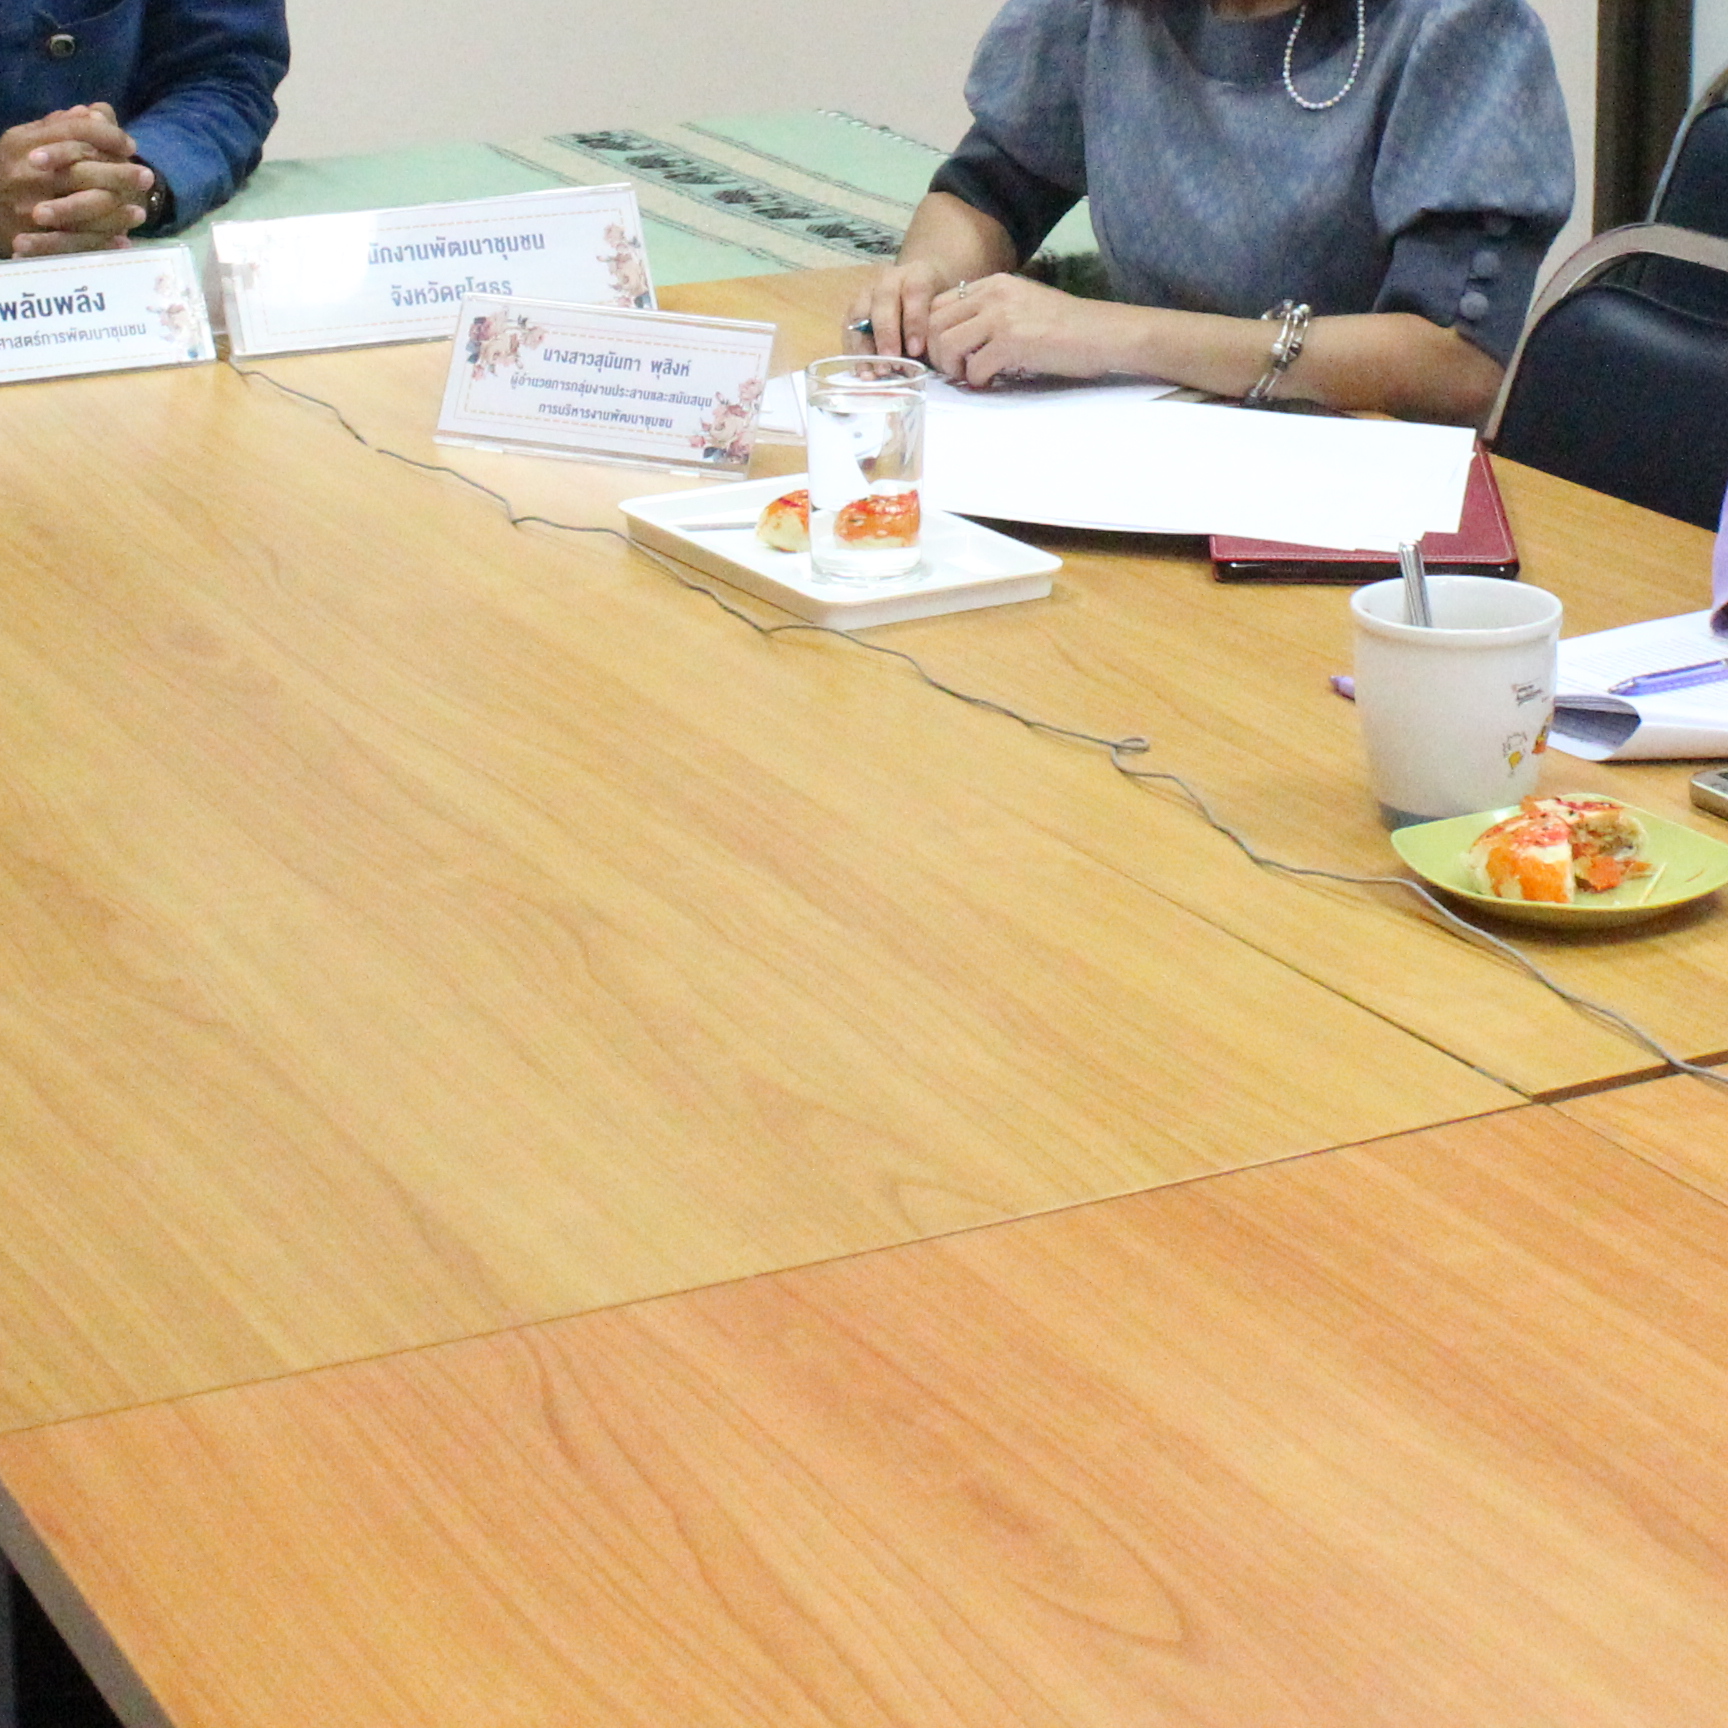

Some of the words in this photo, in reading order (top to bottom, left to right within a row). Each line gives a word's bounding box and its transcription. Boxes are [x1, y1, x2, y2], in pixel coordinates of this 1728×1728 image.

[367, 231, 546, 266] นักงานพัฒนาชุมชน
[542, 346, 642, 373] นางสาวสุนันทา
